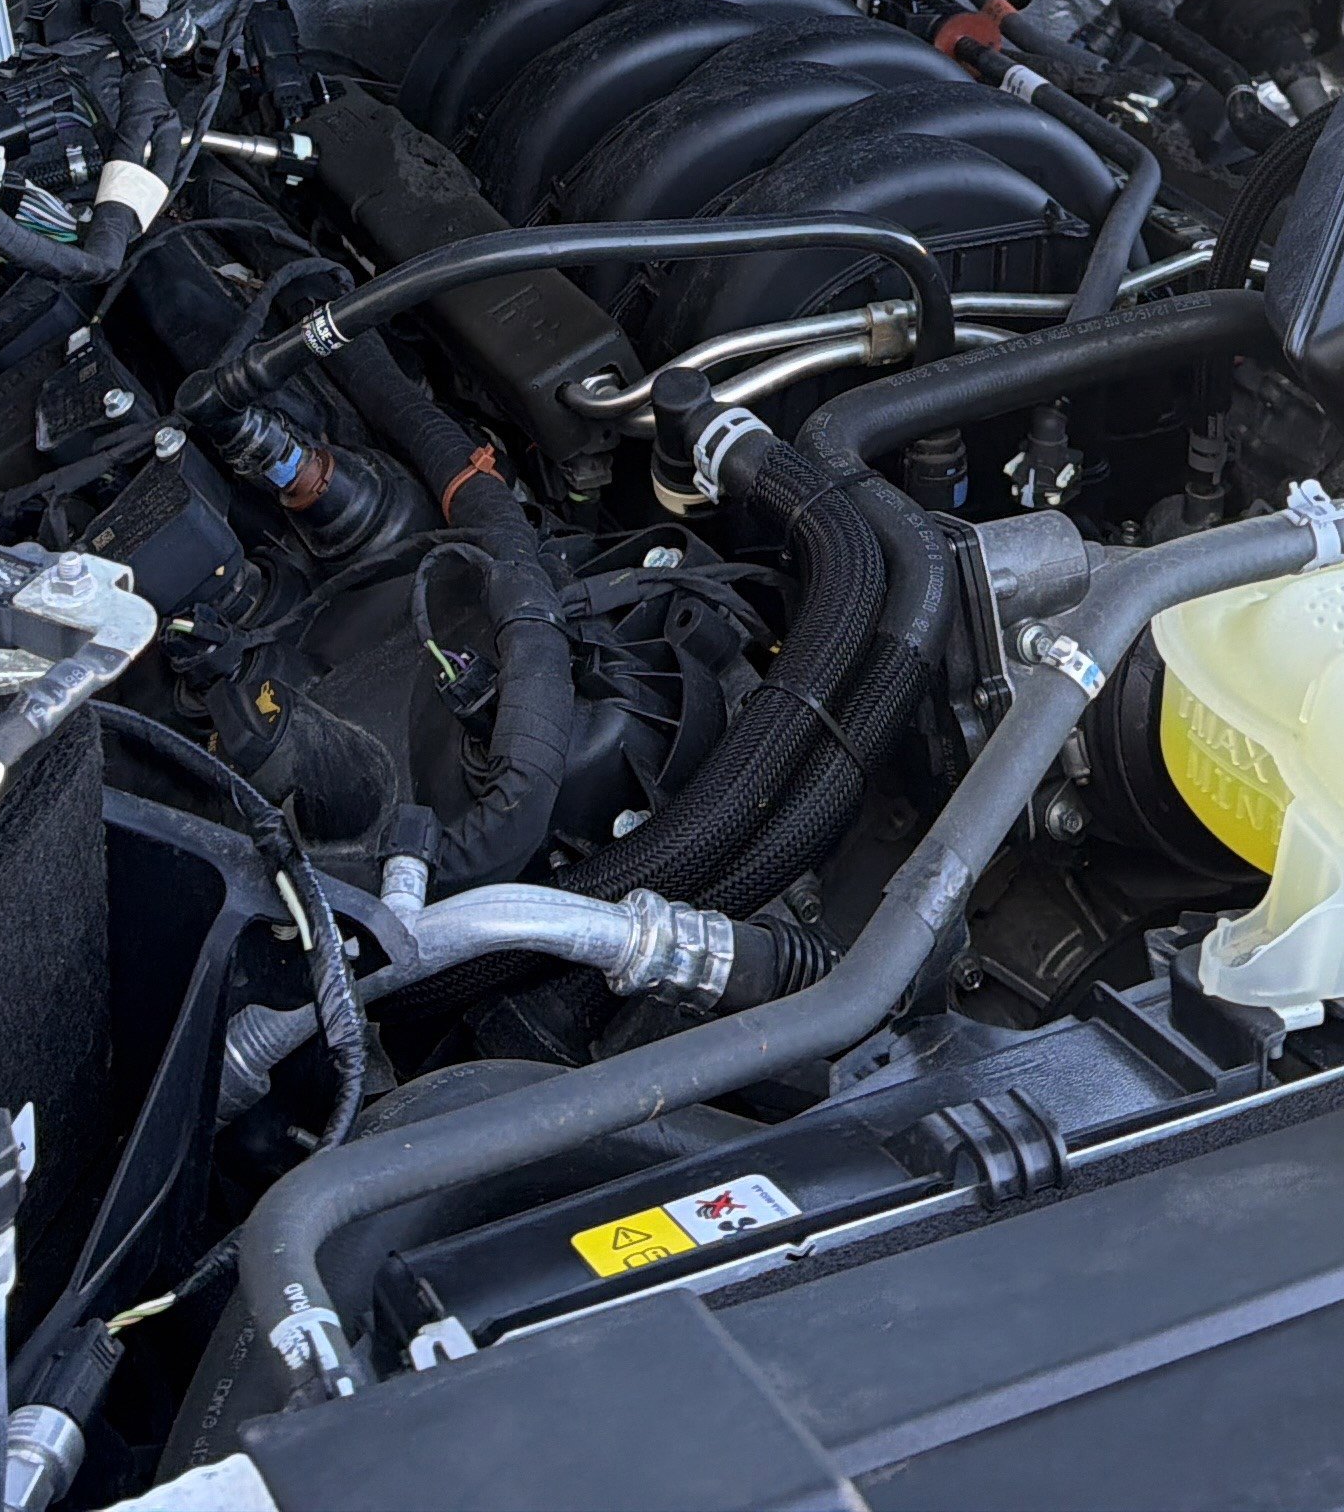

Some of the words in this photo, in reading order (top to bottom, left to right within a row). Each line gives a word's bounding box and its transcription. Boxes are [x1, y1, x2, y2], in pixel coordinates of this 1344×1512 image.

[1192, 701, 1269, 784] MAX
[1187, 749, 1265, 830] MIN
[283, 1282, 311, 1313] RAD
